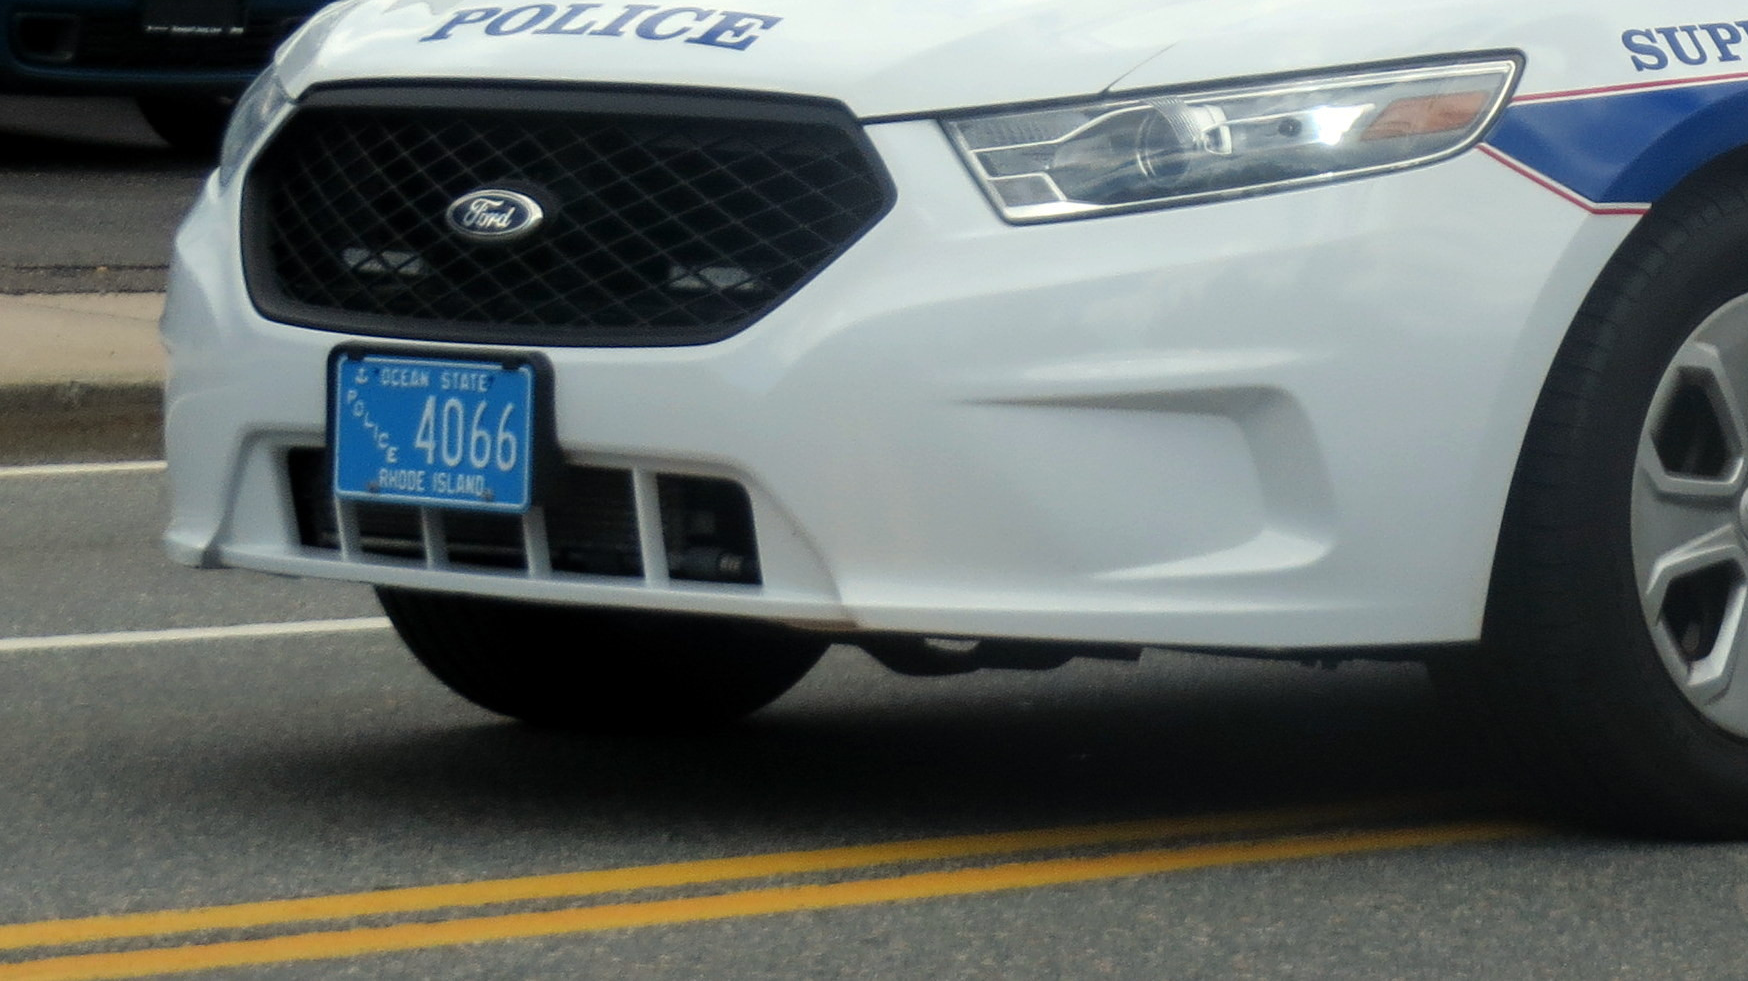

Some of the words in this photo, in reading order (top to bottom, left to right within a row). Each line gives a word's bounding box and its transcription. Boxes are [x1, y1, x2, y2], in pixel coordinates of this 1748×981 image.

[419, 3, 785, 52] POLICE
[463, 198, 516, 228] Ford
[381, 368, 430, 387] OCEAN
[441, 371, 489, 392] STATE
[347, 389, 398, 464] POLICE
[415, 395, 517, 471] 4066
[379, 468, 426, 492] RHODE
[433, 472, 486, 497] ISLAND
